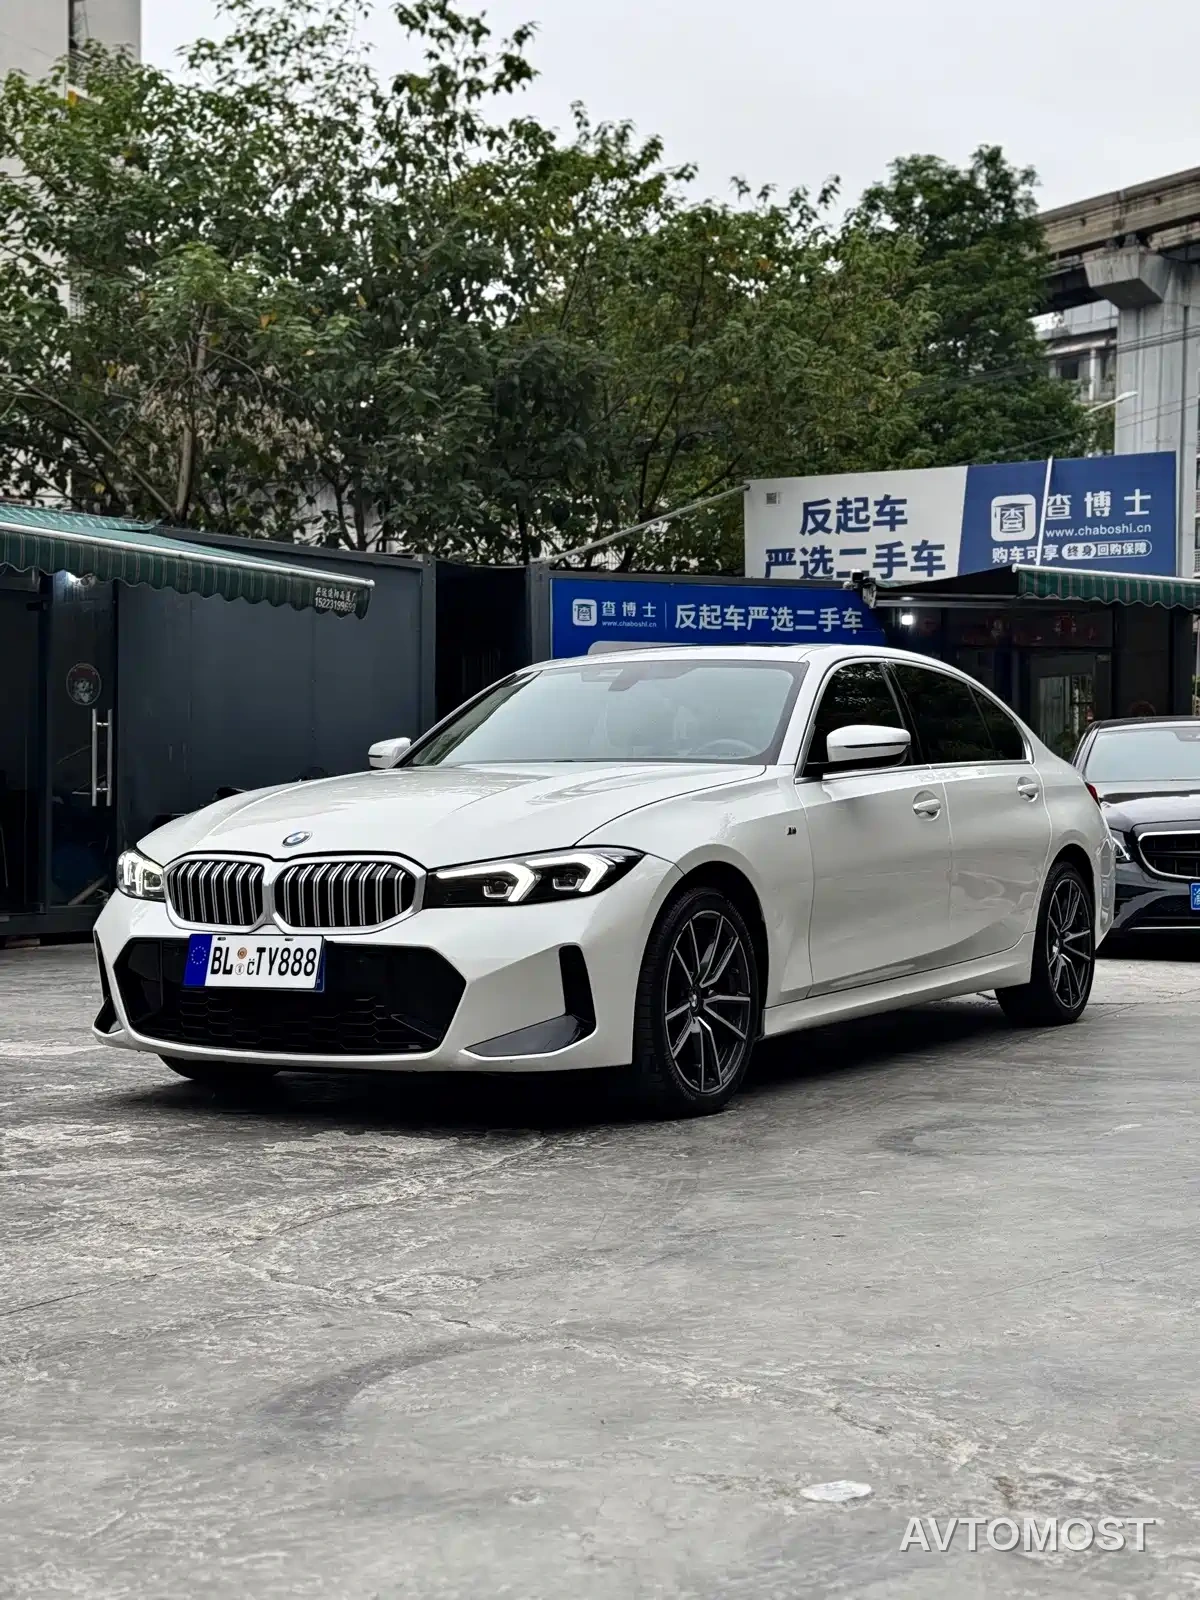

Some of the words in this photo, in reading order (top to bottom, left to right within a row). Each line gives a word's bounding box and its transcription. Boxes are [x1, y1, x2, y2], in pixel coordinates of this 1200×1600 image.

[800, 494, 908, 536] 反起车
[1045, 488, 1151, 520] 查博士
[1045, 523, 1152, 538] www.chaboshi.cn
[765, 540, 946, 579] 严选二手车
[992, 544, 1059, 564] 购车可享
[601, 600, 657, 618] 查博士
[675, 603, 863, 632] 反起车严选二手车
[601, 620, 657, 628] www.chaboshi.cn
[210, 946, 234, 975] BL
